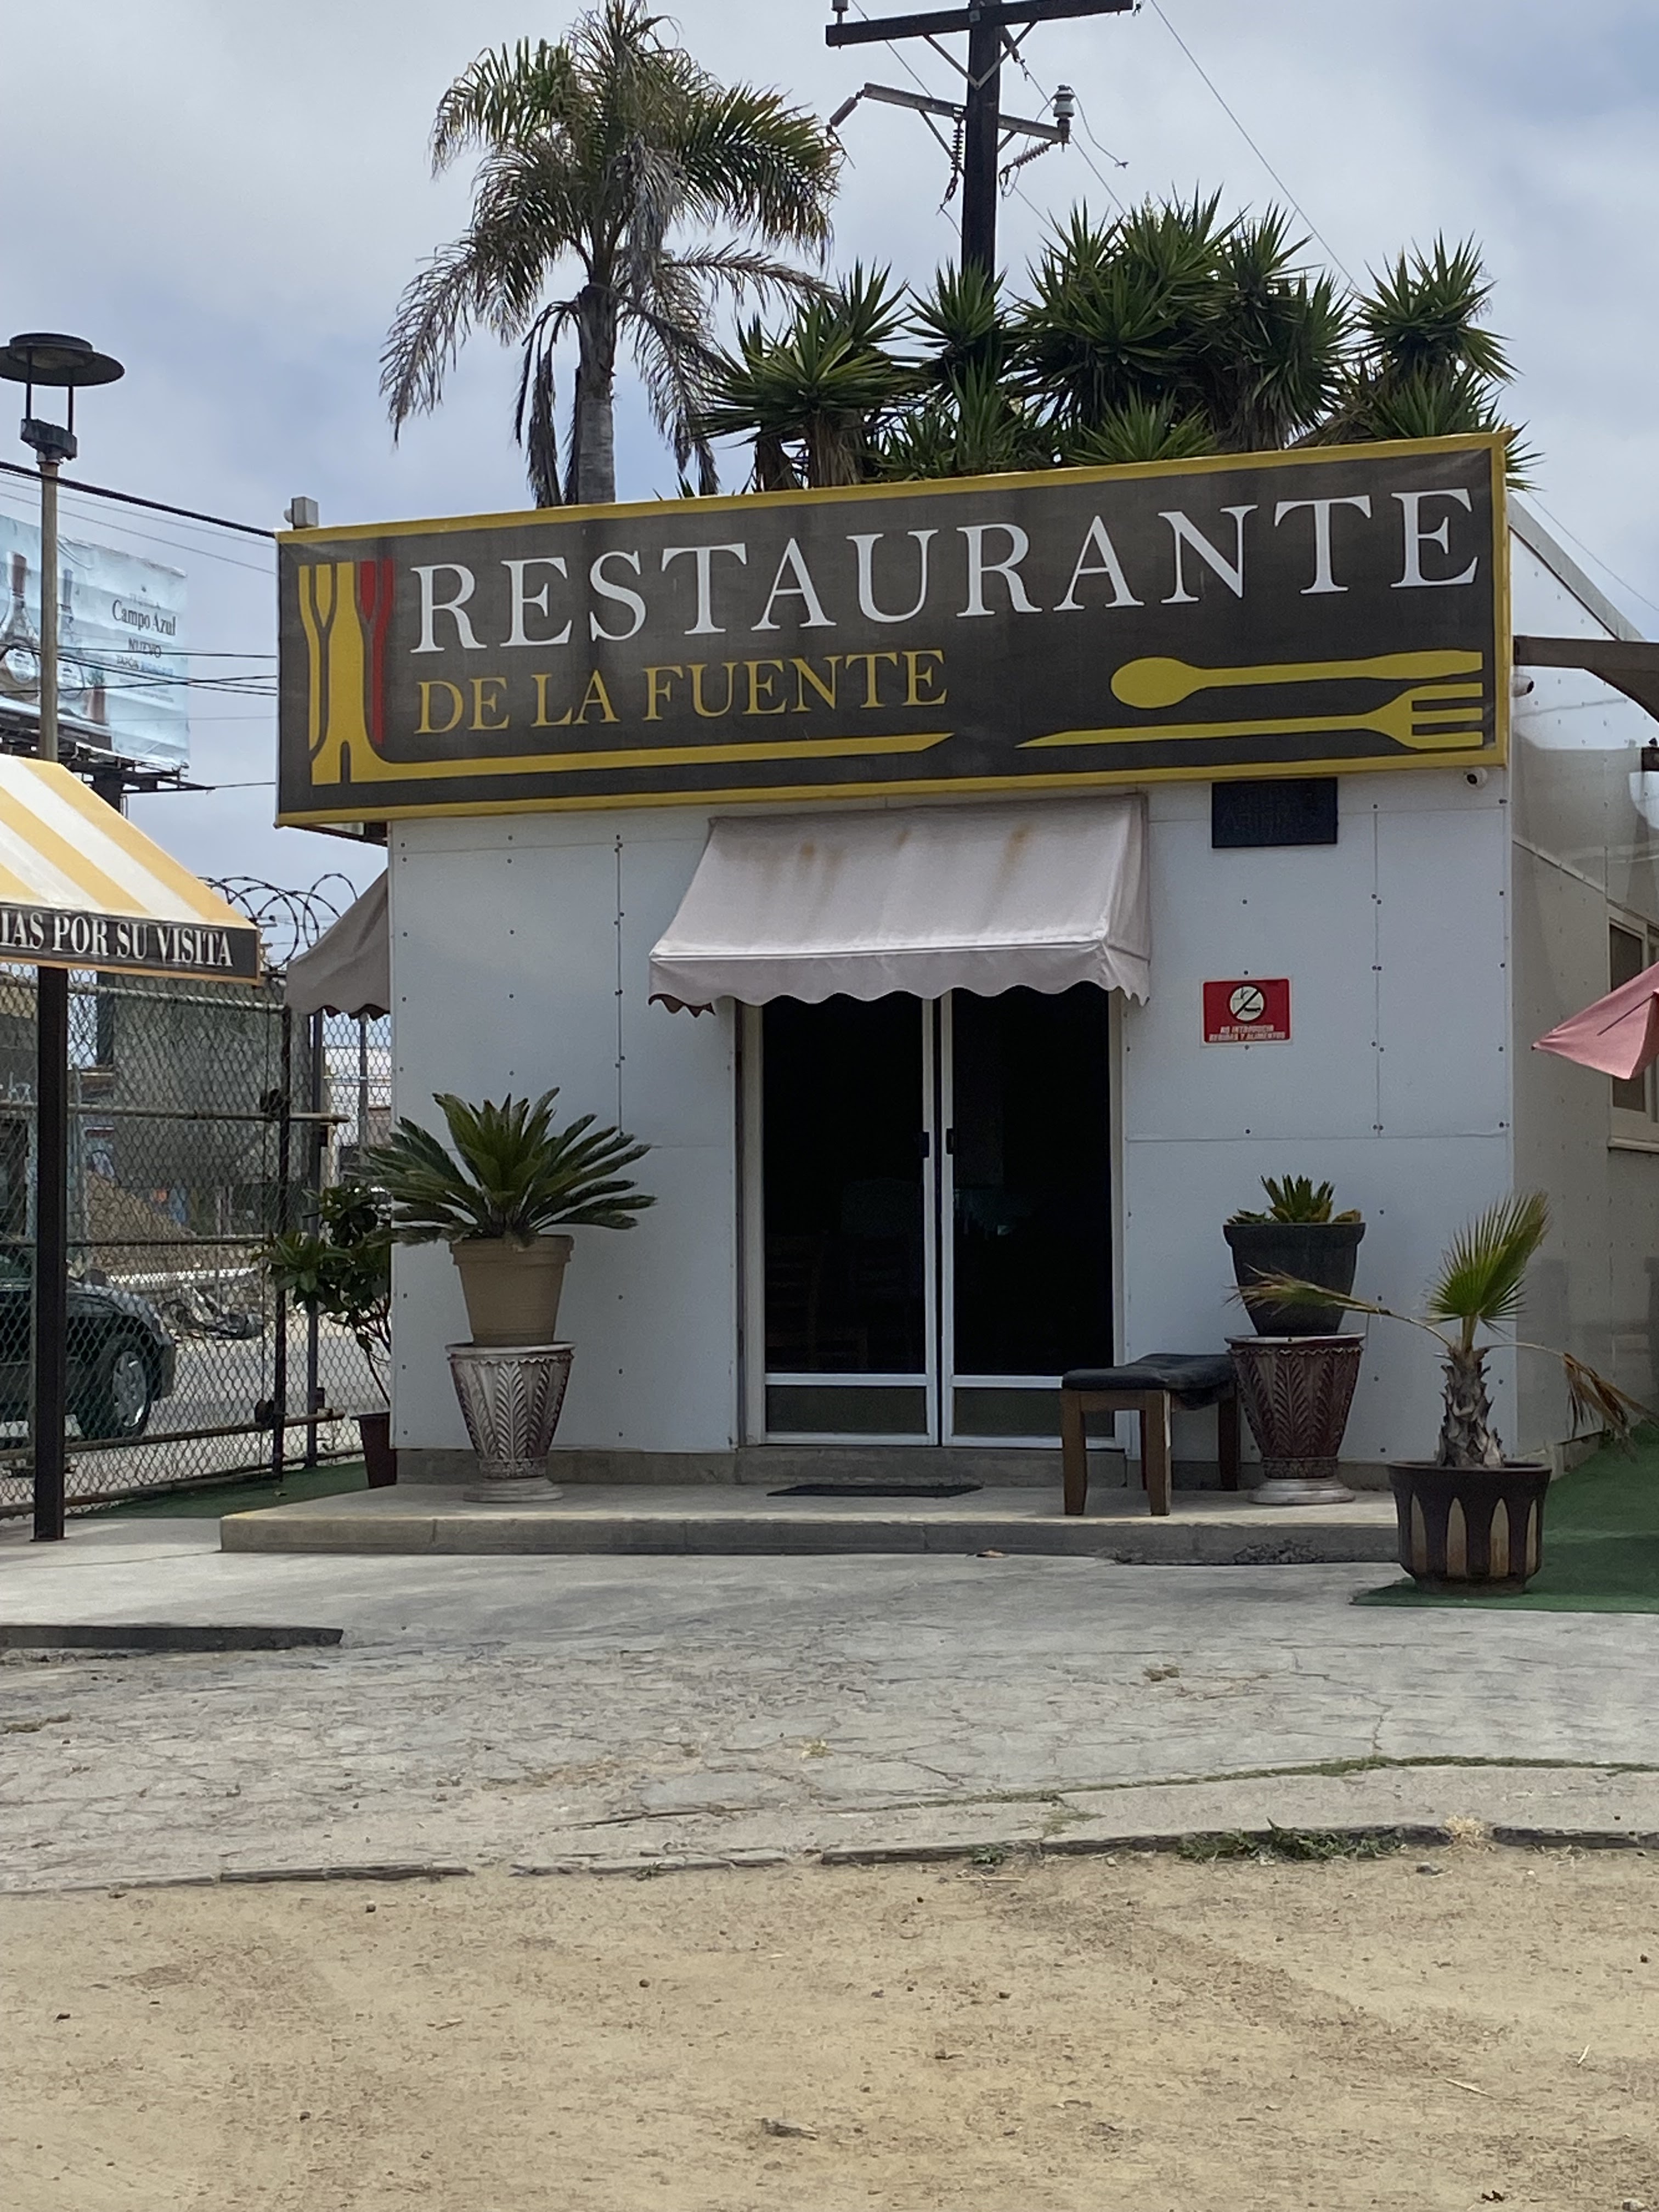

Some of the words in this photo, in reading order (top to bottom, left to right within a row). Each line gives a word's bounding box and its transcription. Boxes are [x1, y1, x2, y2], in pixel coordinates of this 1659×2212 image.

[410, 488, 1477, 653] RESTAURANTE
[112, 599, 150, 630] Campo
[151, 612, 176, 636] Azul
[414, 677, 509, 735] DE
[531, 670, 620, 727] LA
[641, 650, 948, 721] FUENTE
[52, 913, 109, 956] POR
[116, 921, 149, 960] SU
[156, 926, 233, 967] VISITA
